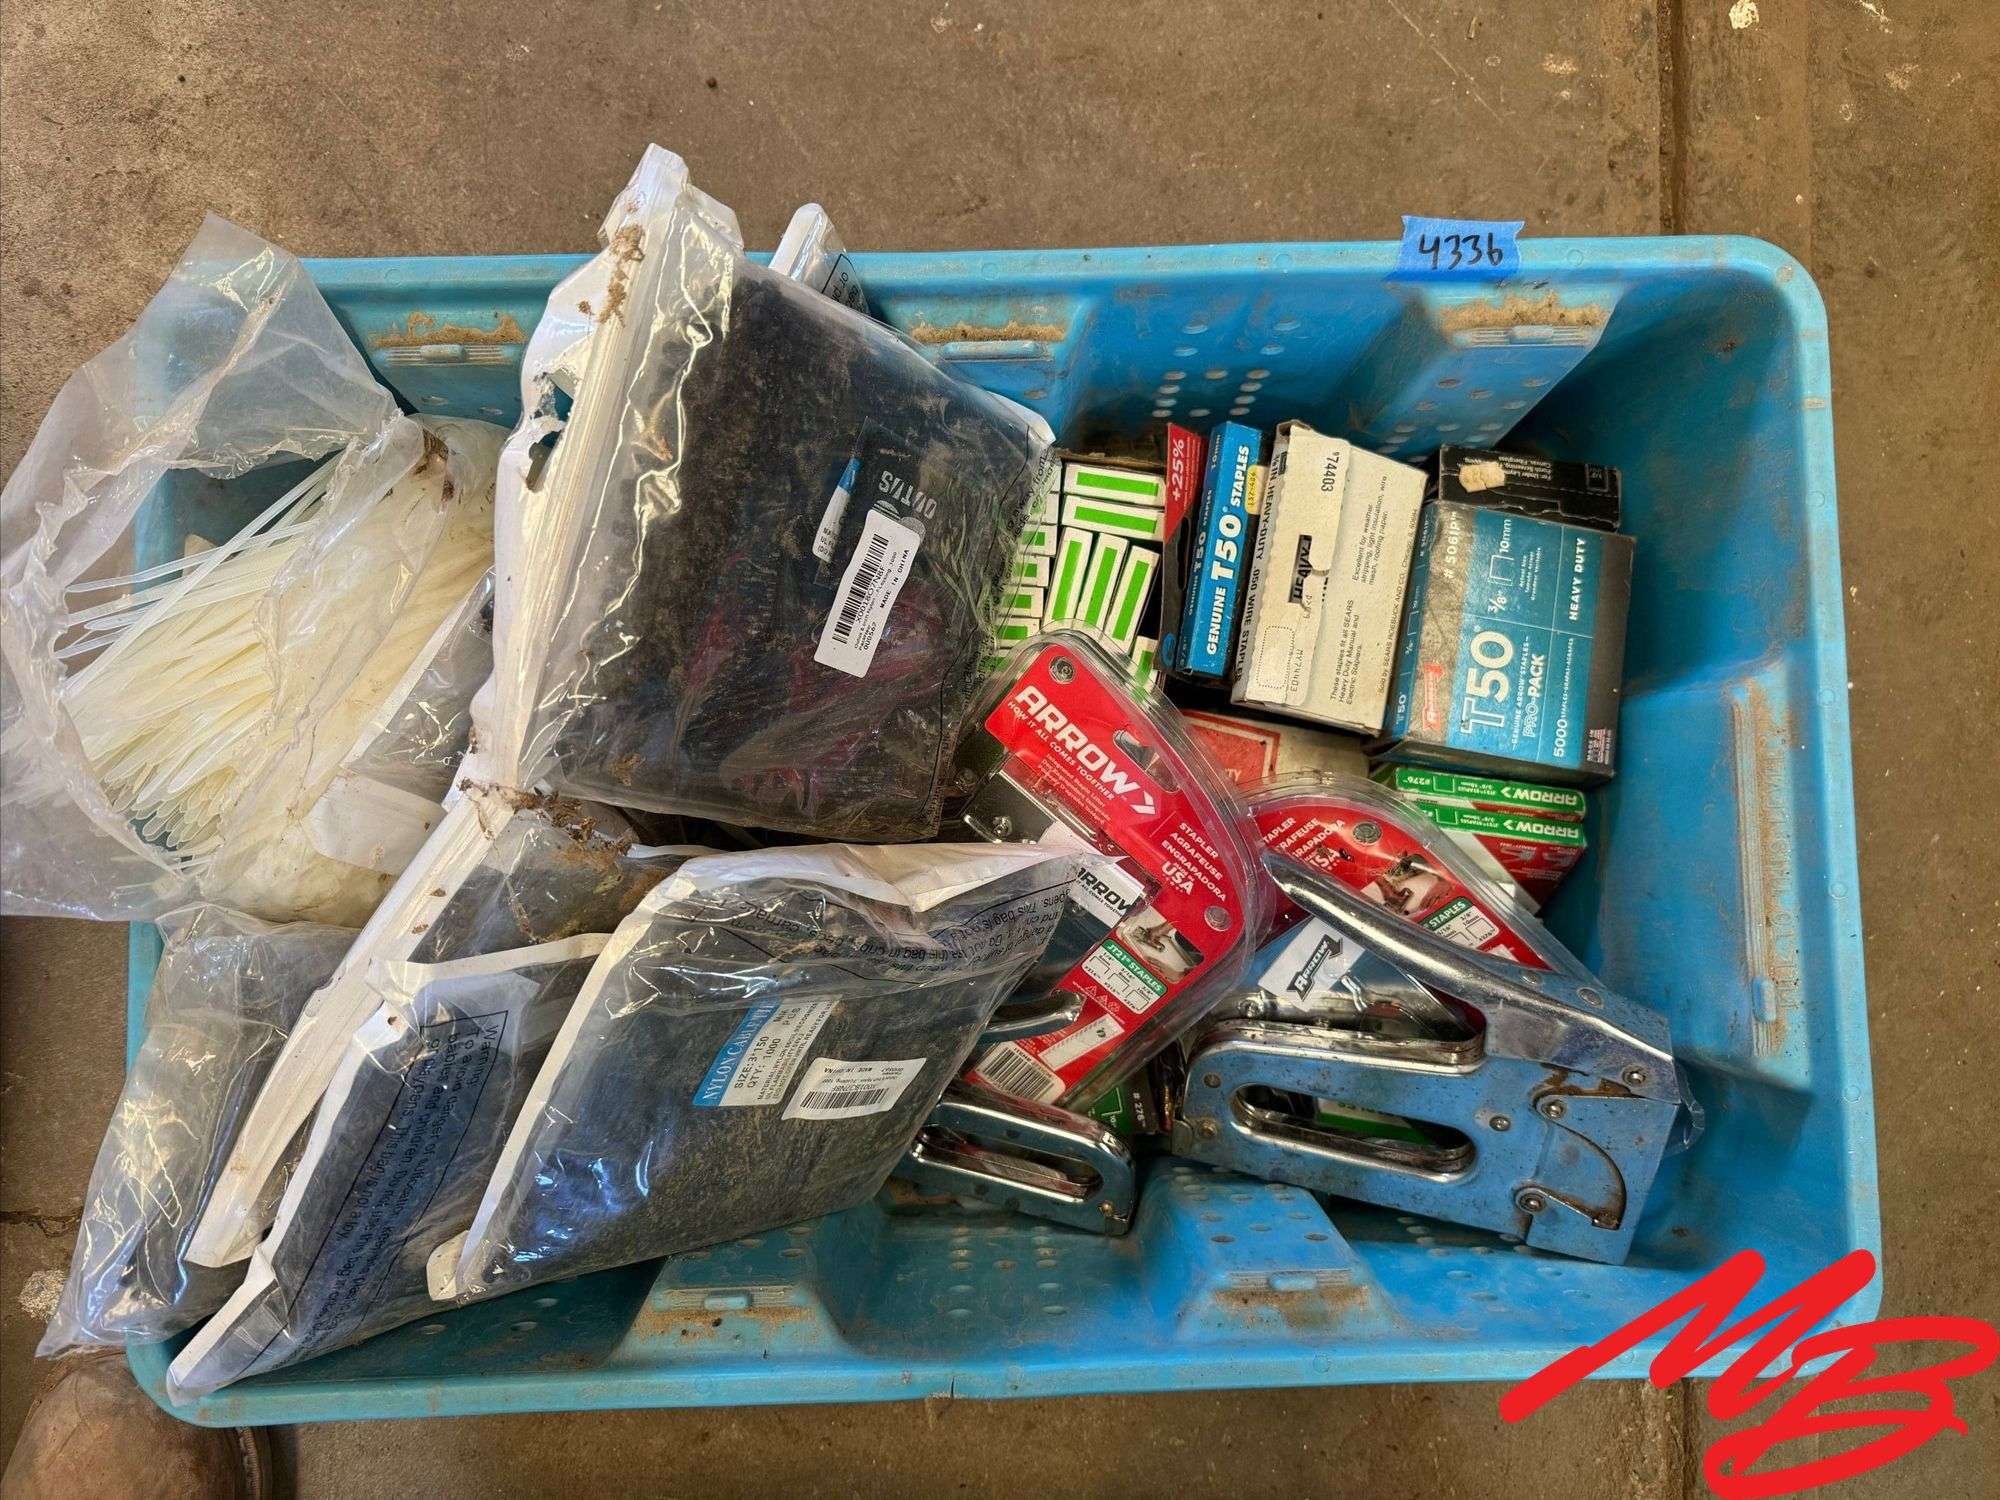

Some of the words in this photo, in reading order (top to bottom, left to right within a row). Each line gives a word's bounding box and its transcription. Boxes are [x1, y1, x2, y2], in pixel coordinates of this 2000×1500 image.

[1419, 232, 1503, 270] 4336
[1170, 438, 1185, 502] +25%
[1227, 444, 1252, 508] STAPLES
[1497, 456, 1528, 464] Fiberglass
[1254, 484, 1275, 561] HEAVY-DUTY
[1496, 518, 1515, 554] 10mm
[894, 548, 911, 573] CHINA
[1191, 529, 1209, 573] T50
[1207, 511, 1246, 583] T50
[1351, 546, 1364, 581] Excellent
[1358, 534, 1367, 545] for
[1372, 534, 1384, 561] roofing
[1571, 536, 1588, 573] DUTY
[890, 575, 899, 586] IN
[1441, 566, 1454, 579] #
[879, 589, 891, 608] MADE
[1242, 593, 1255, 625] WIRE
[1394, 585, 1403, 602] AND
[1565, 576, 1584, 621] HEAVY
[1202, 585, 1230, 655] GENUINE
[1351, 614, 1359, 628] and
[1386, 602, 1400, 640] ROEBUCK
[1329, 676, 1339, 700] These
[1334, 648, 1345, 676] staples
[1343, 599, 1353, 628] SEARS
[1346, 629, 1356, 657] Manual
[1381, 641, 1393, 666] SEARS
[1518, 641, 1530, 675] STAPLES
[1342, 659, 1351, 677] Duty
[1457, 628, 1516, 738] T50
[1338, 678, 1348, 702] Heavy
[1345, 677, 1356, 704] Electric
[1522, 653, 1544, 737] PRO-PACK
[1005, 700, 1029, 722] HOW
[1026, 718, 1037, 729] IT
[1034, 726, 1051, 742] ALL
[1047, 739, 1078, 767] COMES
[1073, 764, 1116, 802] TOGETHER
[1013, 682, 1141, 801] ARROW
[1551, 717, 1571, 757] 5000
[1511, 785, 1577, 807] ARROW
[1177, 820, 1220, 860] STAPLER
[1515, 819, 1579, 839] ARROW
[1159, 838, 1229, 902] ENGRAPADORA
[1168, 830, 1224, 881] AGRAFEUSE
[1159, 859, 1197, 895] USA
[994, 912, 1016, 926] bag
[1427, 899, 1466, 928] STAPLES
[903, 944, 925, 960] bag
[1128, 961, 1162, 991] STAPLES
[702, 1055, 736, 1100] NYLON
[745, 1063, 765, 1090] QTY:
[762, 1035, 782, 1062] 1000
[424, 1084, 444, 1112] and
[427, 1091, 459, 1140] danger
[387, 1120, 410, 1151] This
[423, 1141, 438, 1157] of
[366, 1176, 378, 1188] is
[348, 1208, 361, 1221] a
[354, 1188, 373, 1210] not
[335, 1253, 358, 1280] bag
